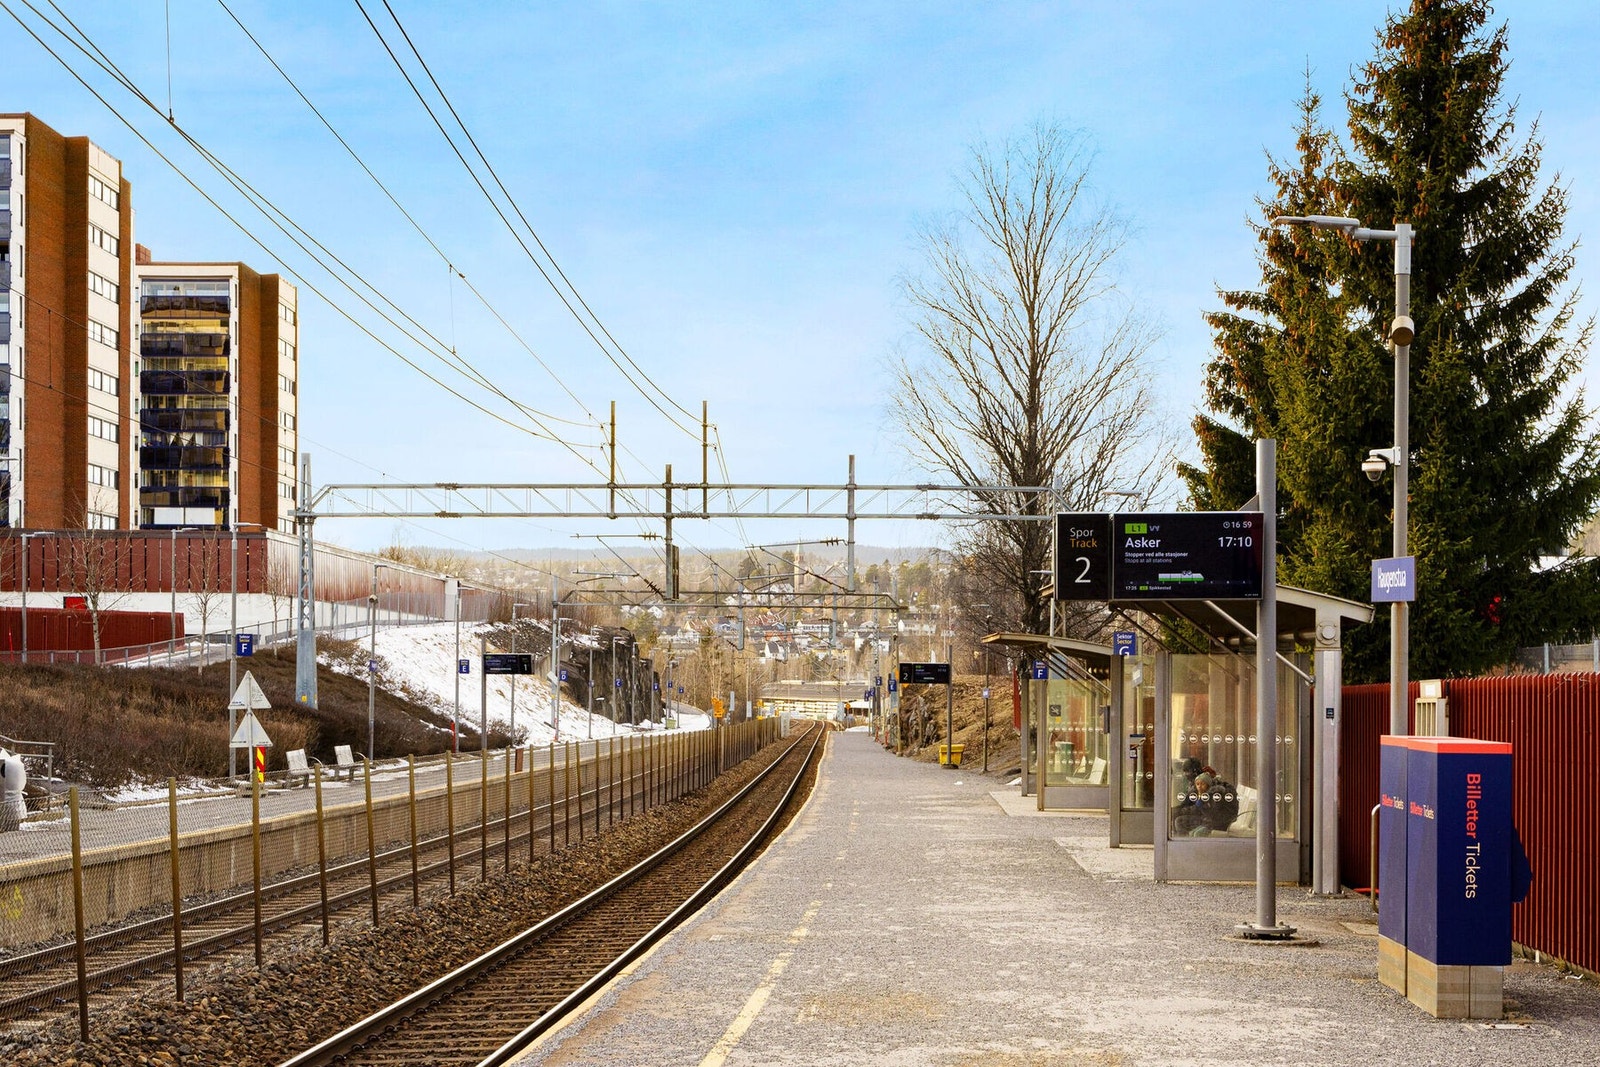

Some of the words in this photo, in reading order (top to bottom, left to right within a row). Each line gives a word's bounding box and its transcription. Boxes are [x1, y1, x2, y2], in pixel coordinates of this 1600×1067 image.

[1069, 527, 1094, 539] Spor
[1131, 524, 1141, 532] L1
[1069, 538, 1098, 548] Track
[1125, 537, 1162, 548] Asker
[1218, 536, 1252, 548] 17:10
[1075, 556, 1091, 583] 2
[241, 643, 248, 653] F
[1119, 646, 1129, 659] G
[1037, 669, 1044, 679] F
[1423, 804, 1435, 820] Tickets
[1466, 773, 1481, 839] Billetter
[1465, 842, 1480, 899] Tickets
